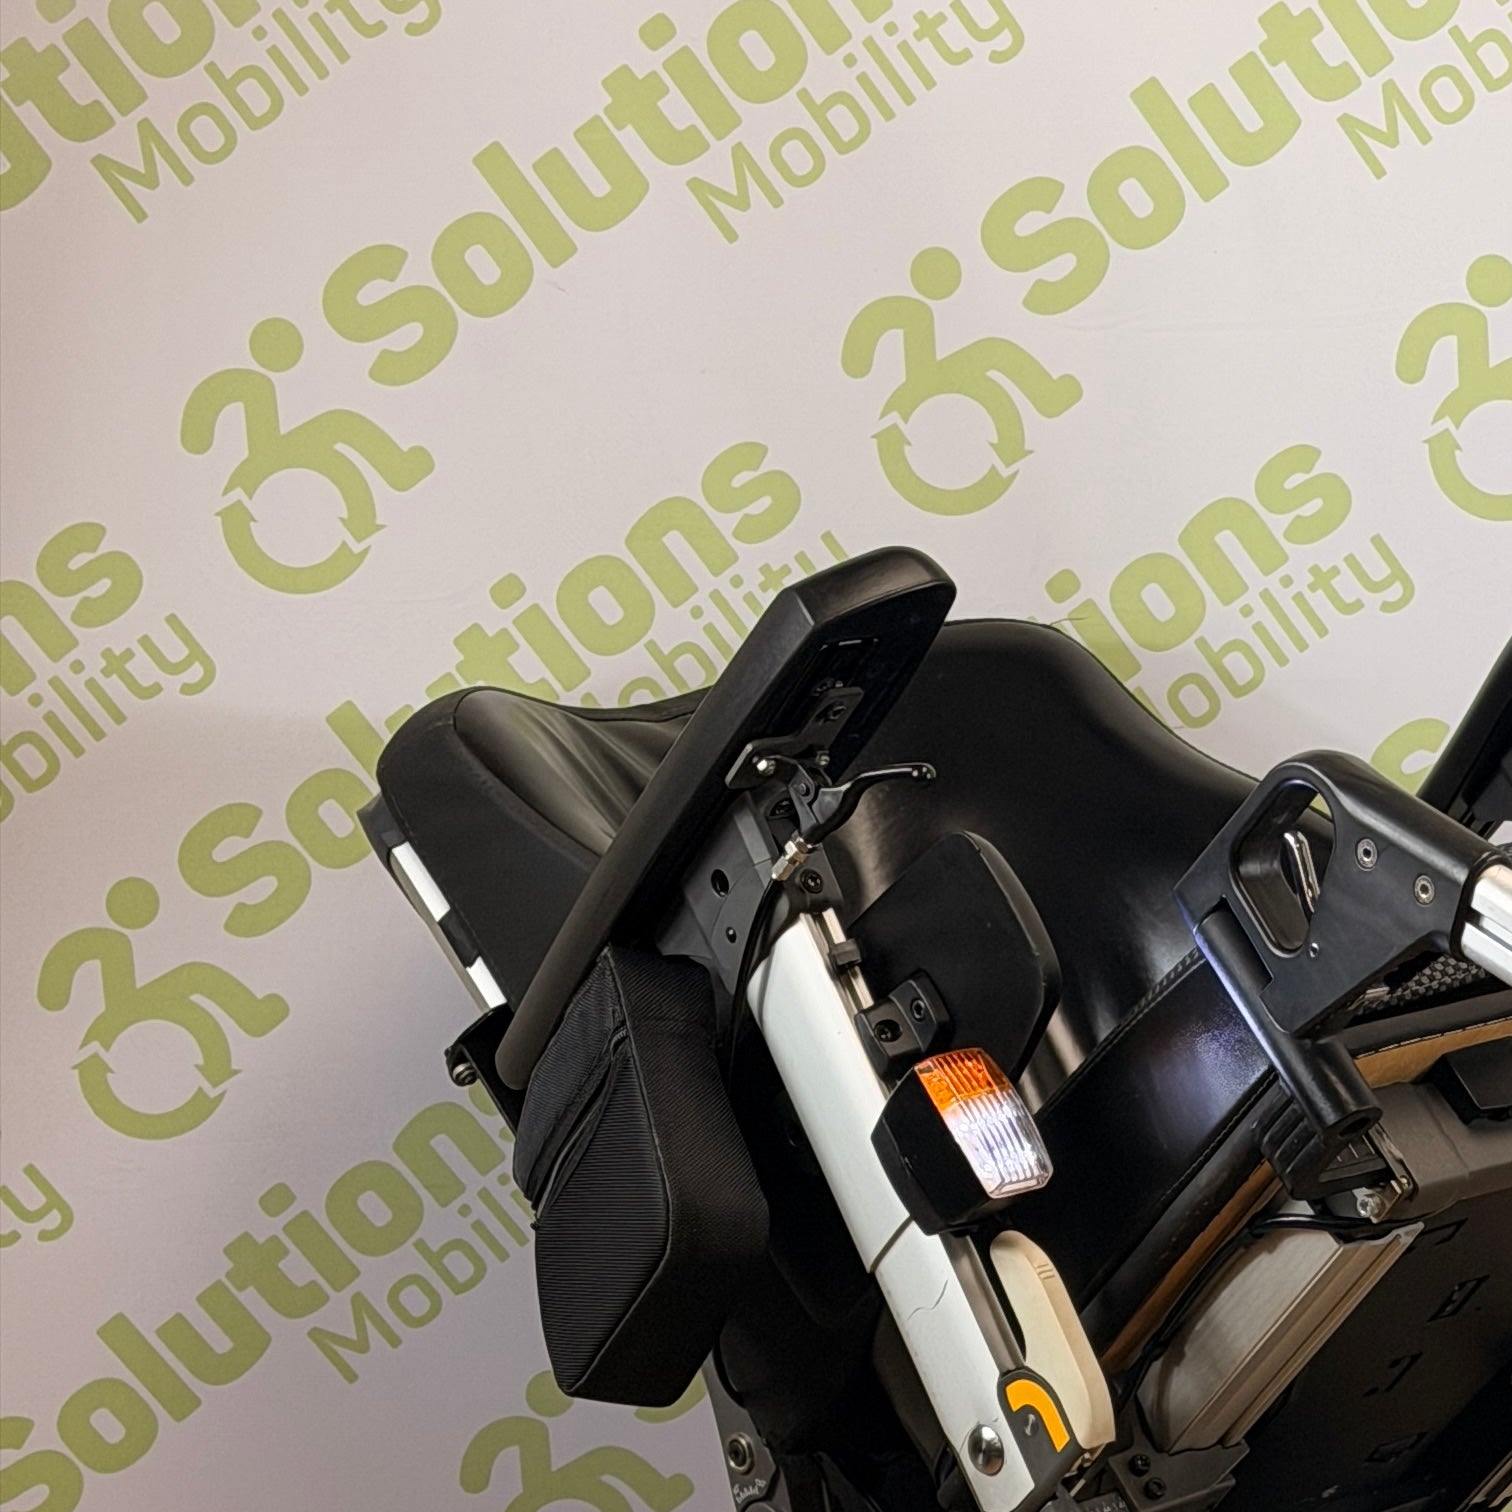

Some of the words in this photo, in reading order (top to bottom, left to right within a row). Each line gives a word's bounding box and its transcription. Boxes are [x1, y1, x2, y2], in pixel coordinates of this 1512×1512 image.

[1046, 446, 1350, 683] ions
[1134, 537, 1413, 728] obility
[0, 615, 215, 823] bility
[0, 1166, 72, 1248] y
